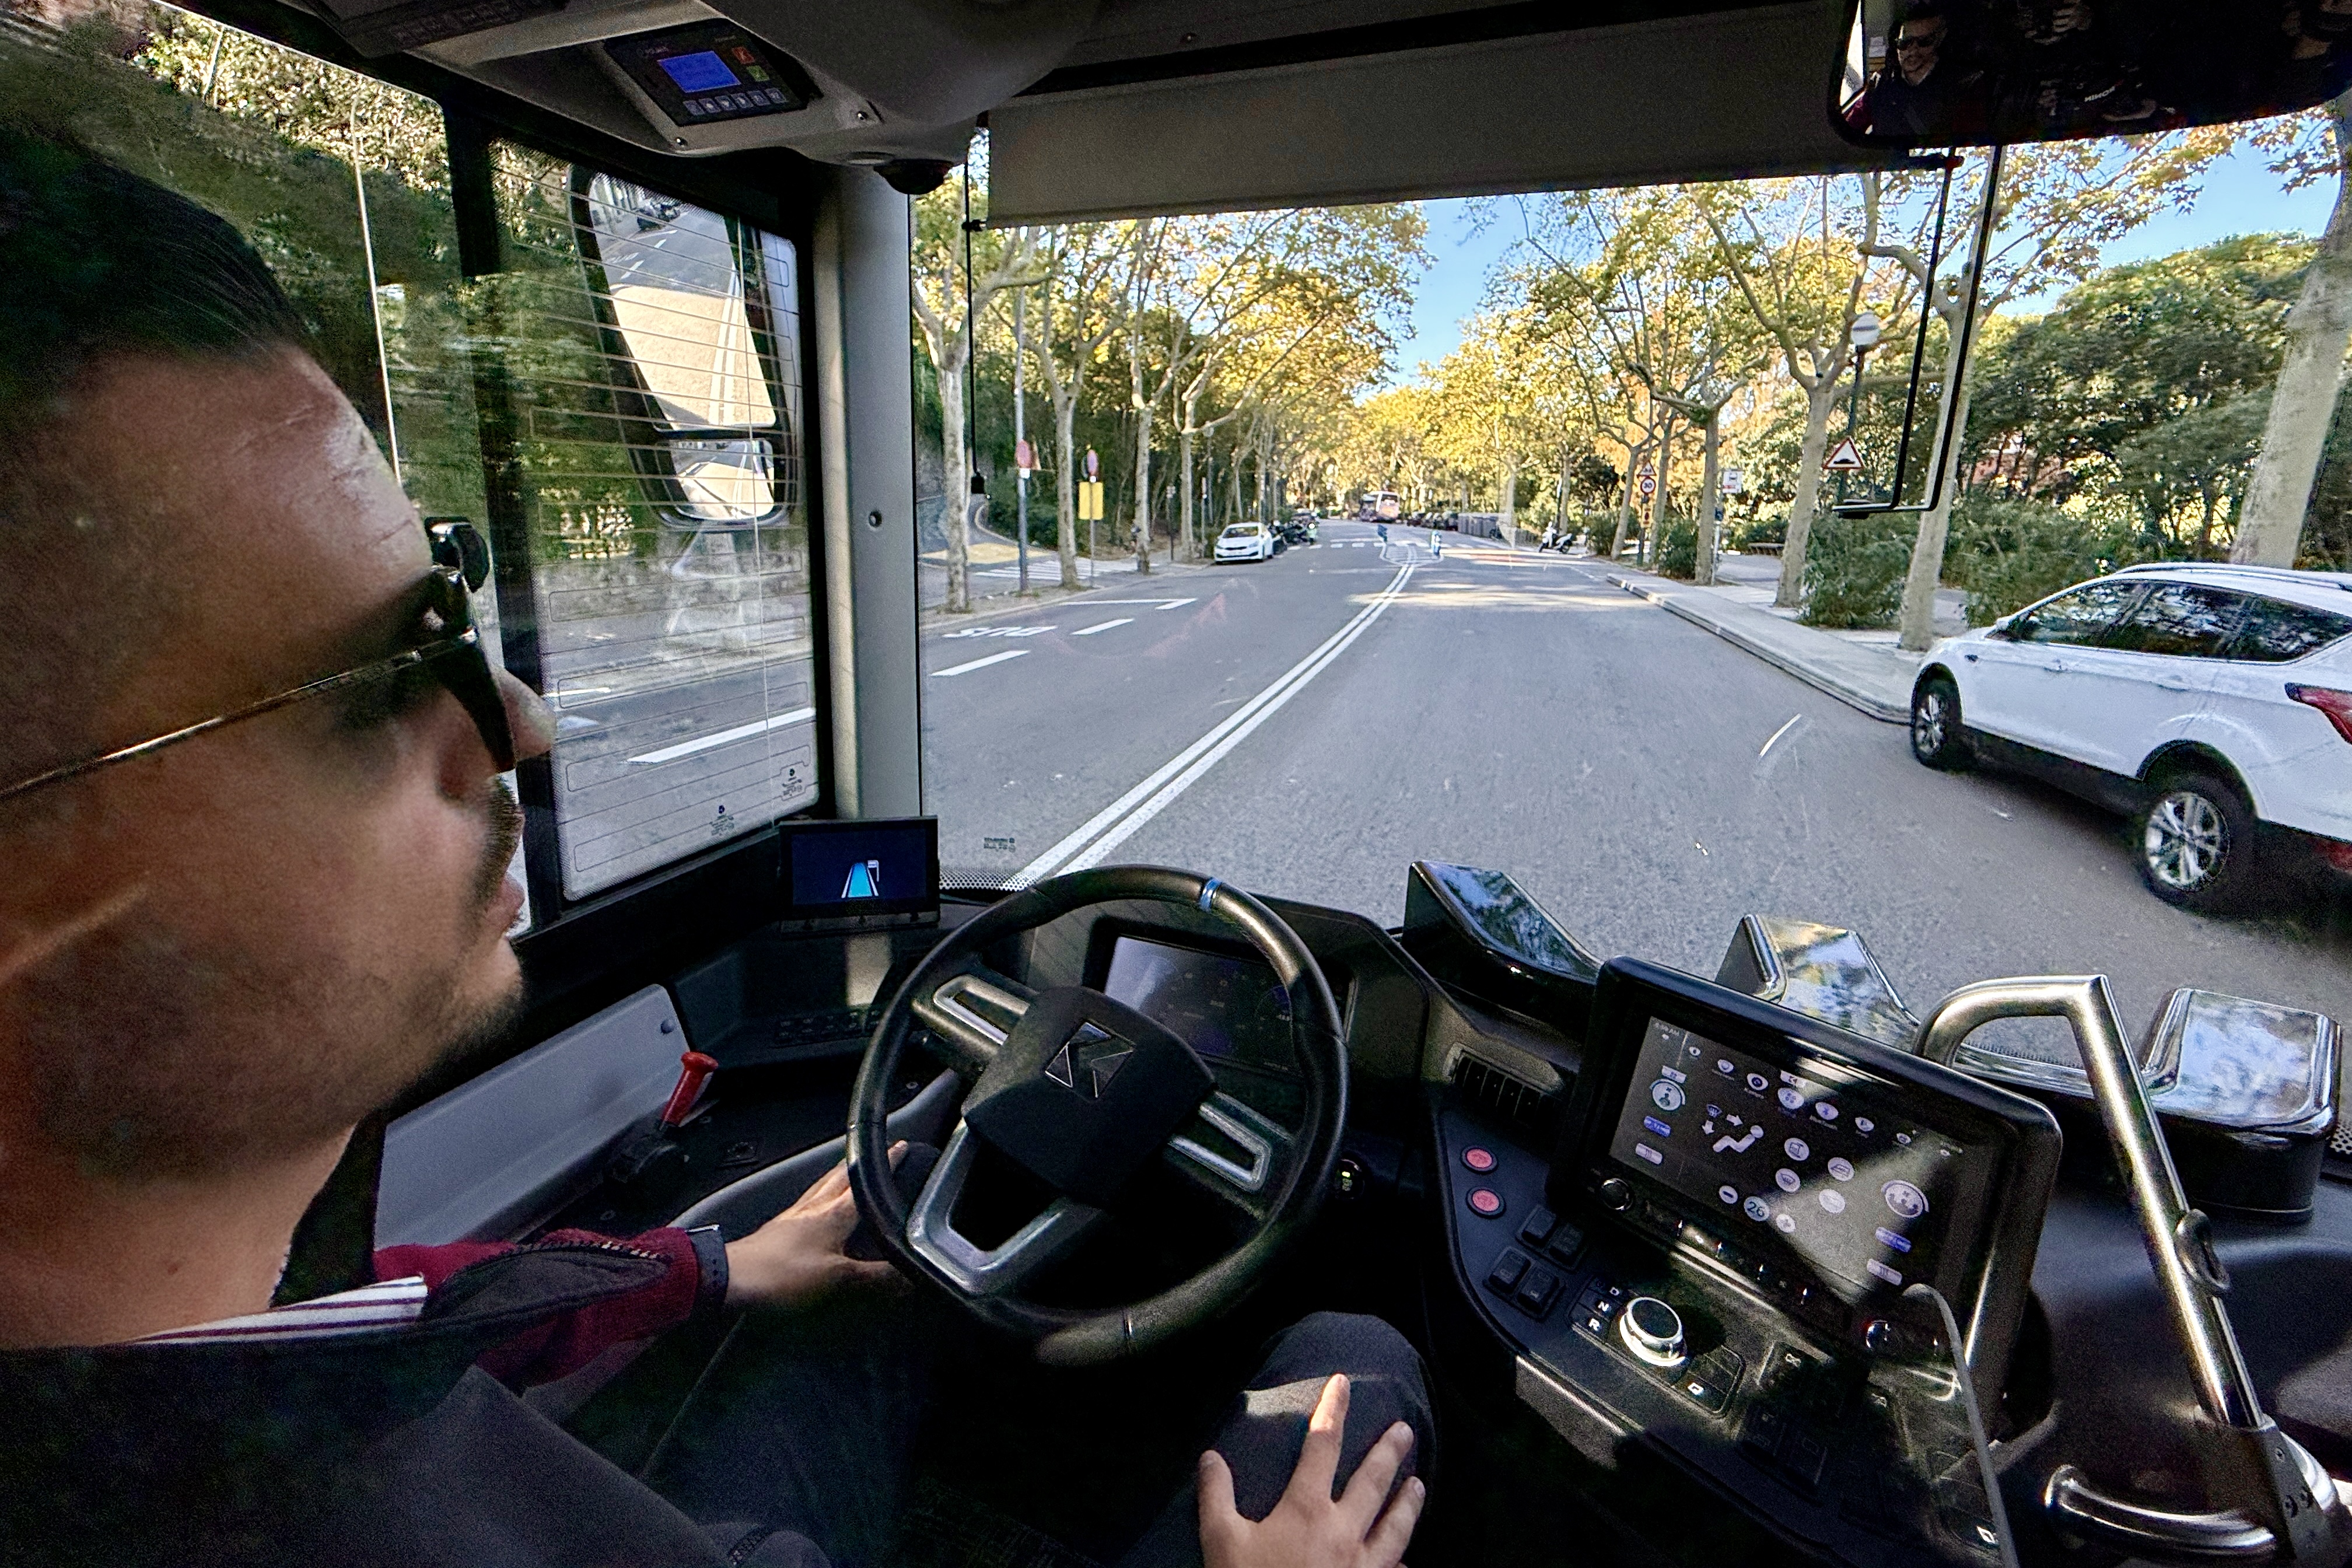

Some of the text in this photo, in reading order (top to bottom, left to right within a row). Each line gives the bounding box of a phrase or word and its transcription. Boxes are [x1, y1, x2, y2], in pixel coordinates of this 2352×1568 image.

[1747, 1201, 1765, 1218] 26
[1598, 1301, 1610, 1312] N
[1588, 1318, 1601, 1331] R
